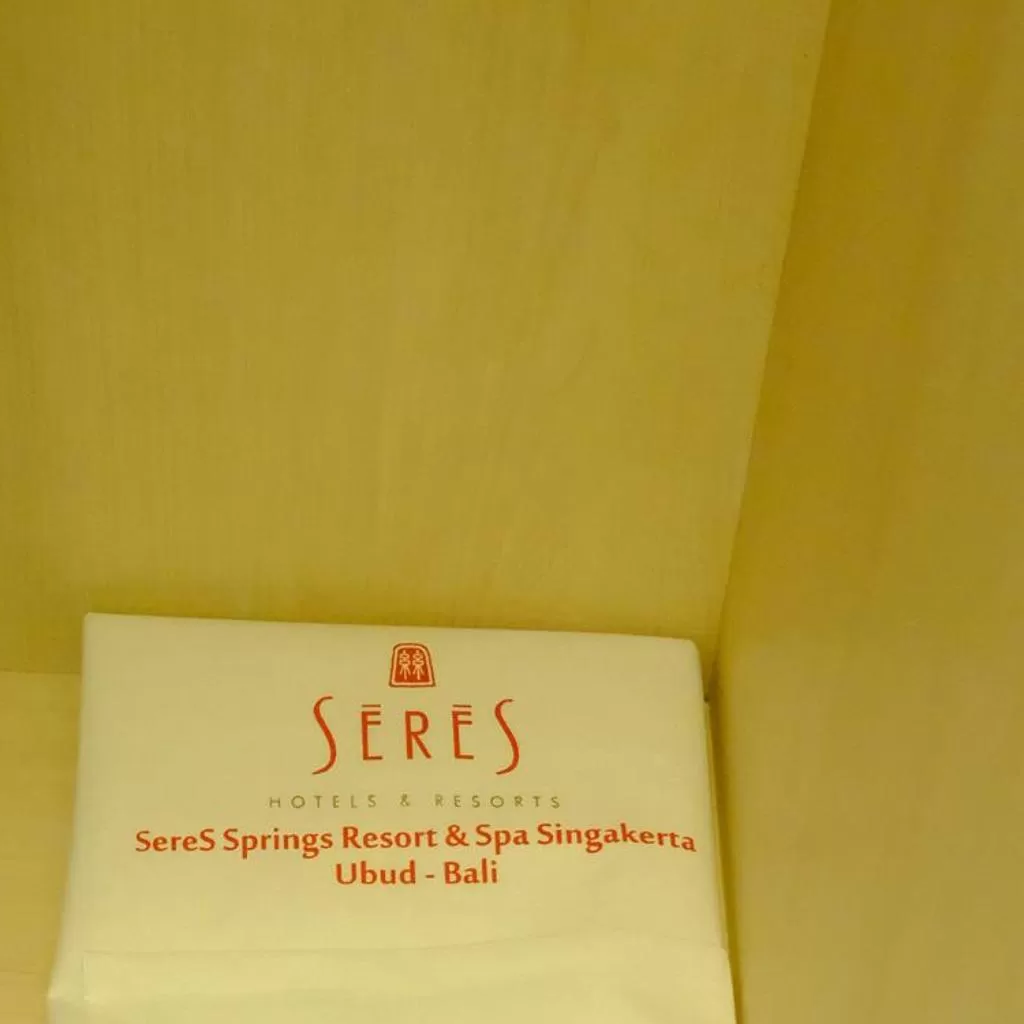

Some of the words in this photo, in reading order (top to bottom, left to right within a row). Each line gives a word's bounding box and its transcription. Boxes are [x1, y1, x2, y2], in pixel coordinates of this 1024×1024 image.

[269, 793, 377, 810] HOTELS
[400, 792, 412, 808] &
[435, 793, 561, 810] RESORTS
[135, 828, 217, 853] SereS
[222, 827, 334, 861] Springs
[342, 825, 438, 850] Resort
[444, 824, 470, 848] &
[475, 823, 530, 855] Spa
[536, 822, 697, 855] Singakerta
[335, 859, 417, 886] Ubud
[443, 858, 498, 886] Bali
